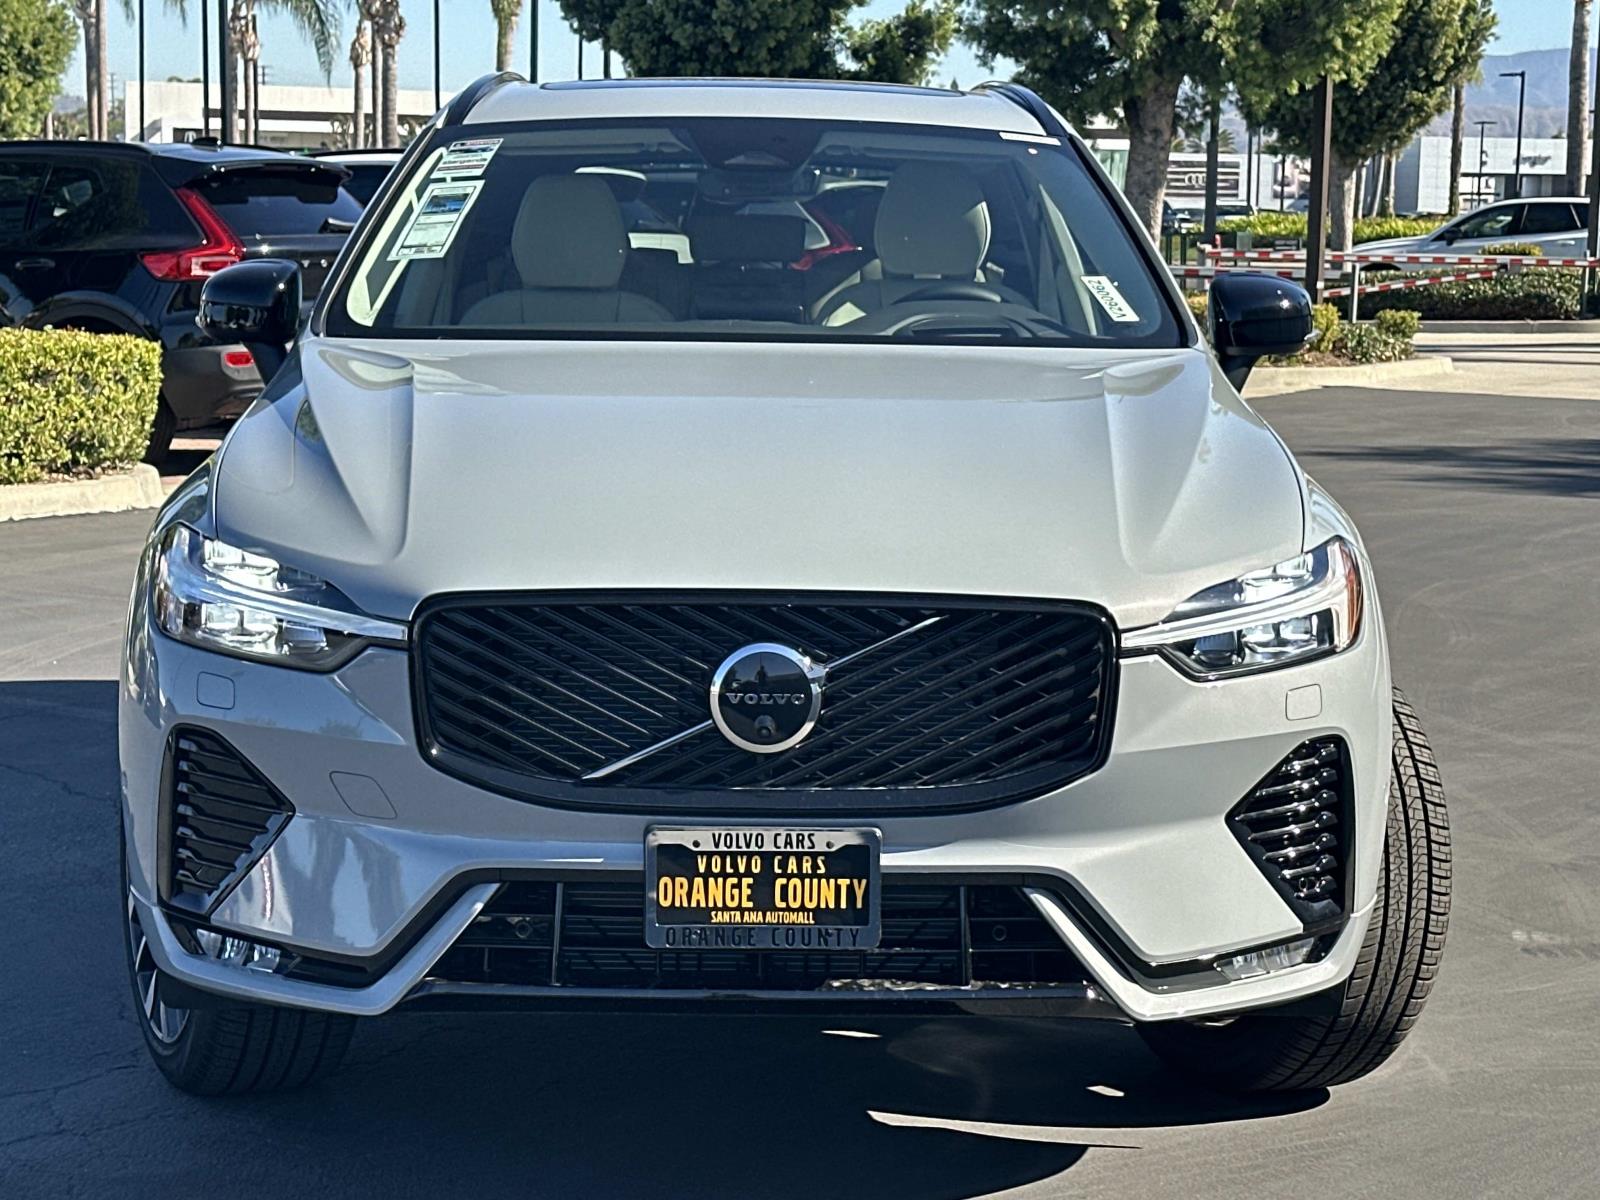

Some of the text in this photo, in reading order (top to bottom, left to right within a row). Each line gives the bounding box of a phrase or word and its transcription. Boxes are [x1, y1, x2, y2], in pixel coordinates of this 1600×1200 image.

[725, 693, 805, 705] VOLVO
[711, 832, 816, 850] VOLVO CARS
[696, 855, 826, 874] VOLVO CARS
[658, 876, 867, 909] ORANGE COUNTY
[711, 910, 815, 925] SANTA ANA AUTOMALL
[665, 927, 861, 947] ORANGE COUNTY
